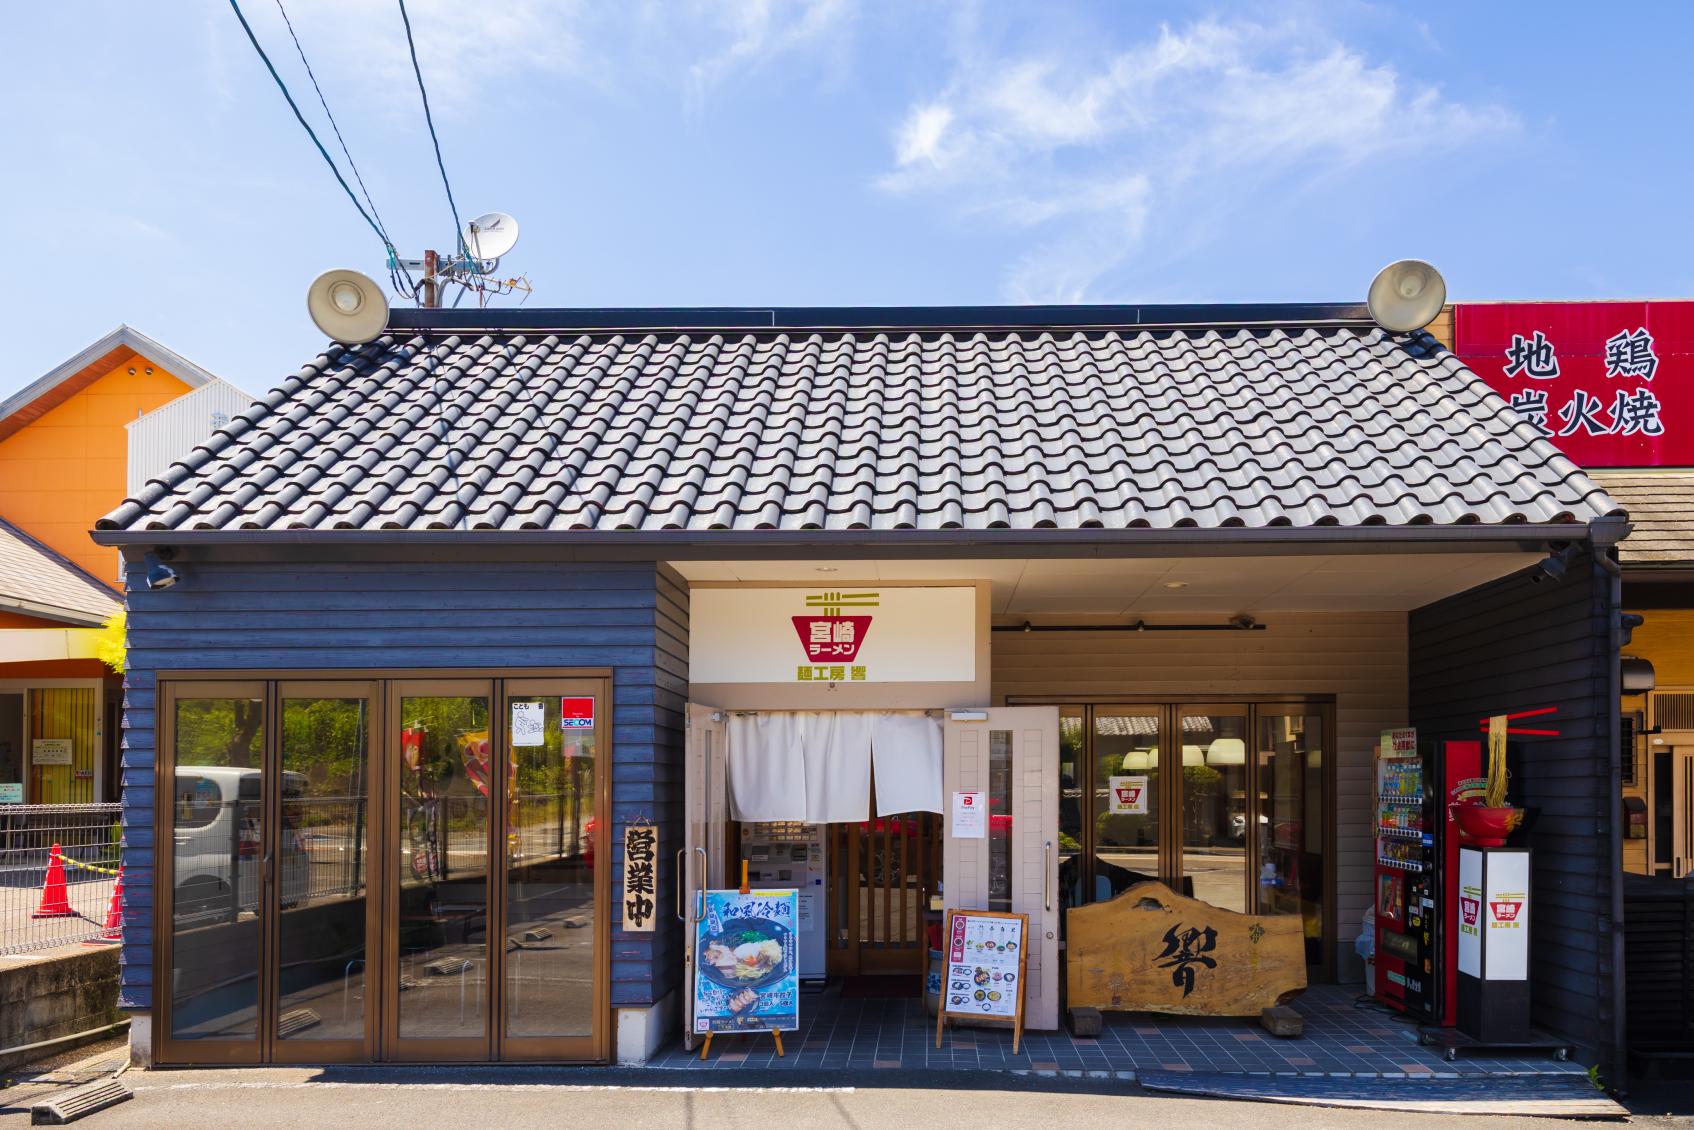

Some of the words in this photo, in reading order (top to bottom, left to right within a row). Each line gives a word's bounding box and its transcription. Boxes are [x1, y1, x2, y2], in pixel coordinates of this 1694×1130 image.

[809, 621, 855, 643] 宮崎
[809, 643, 855, 655] ラーメン
[797, 666, 845, 681] 麺工房
[850, 666, 866, 681] 響
[626, 829, 656, 927] 営業中
[1152, 921, 1218, 999] 響
